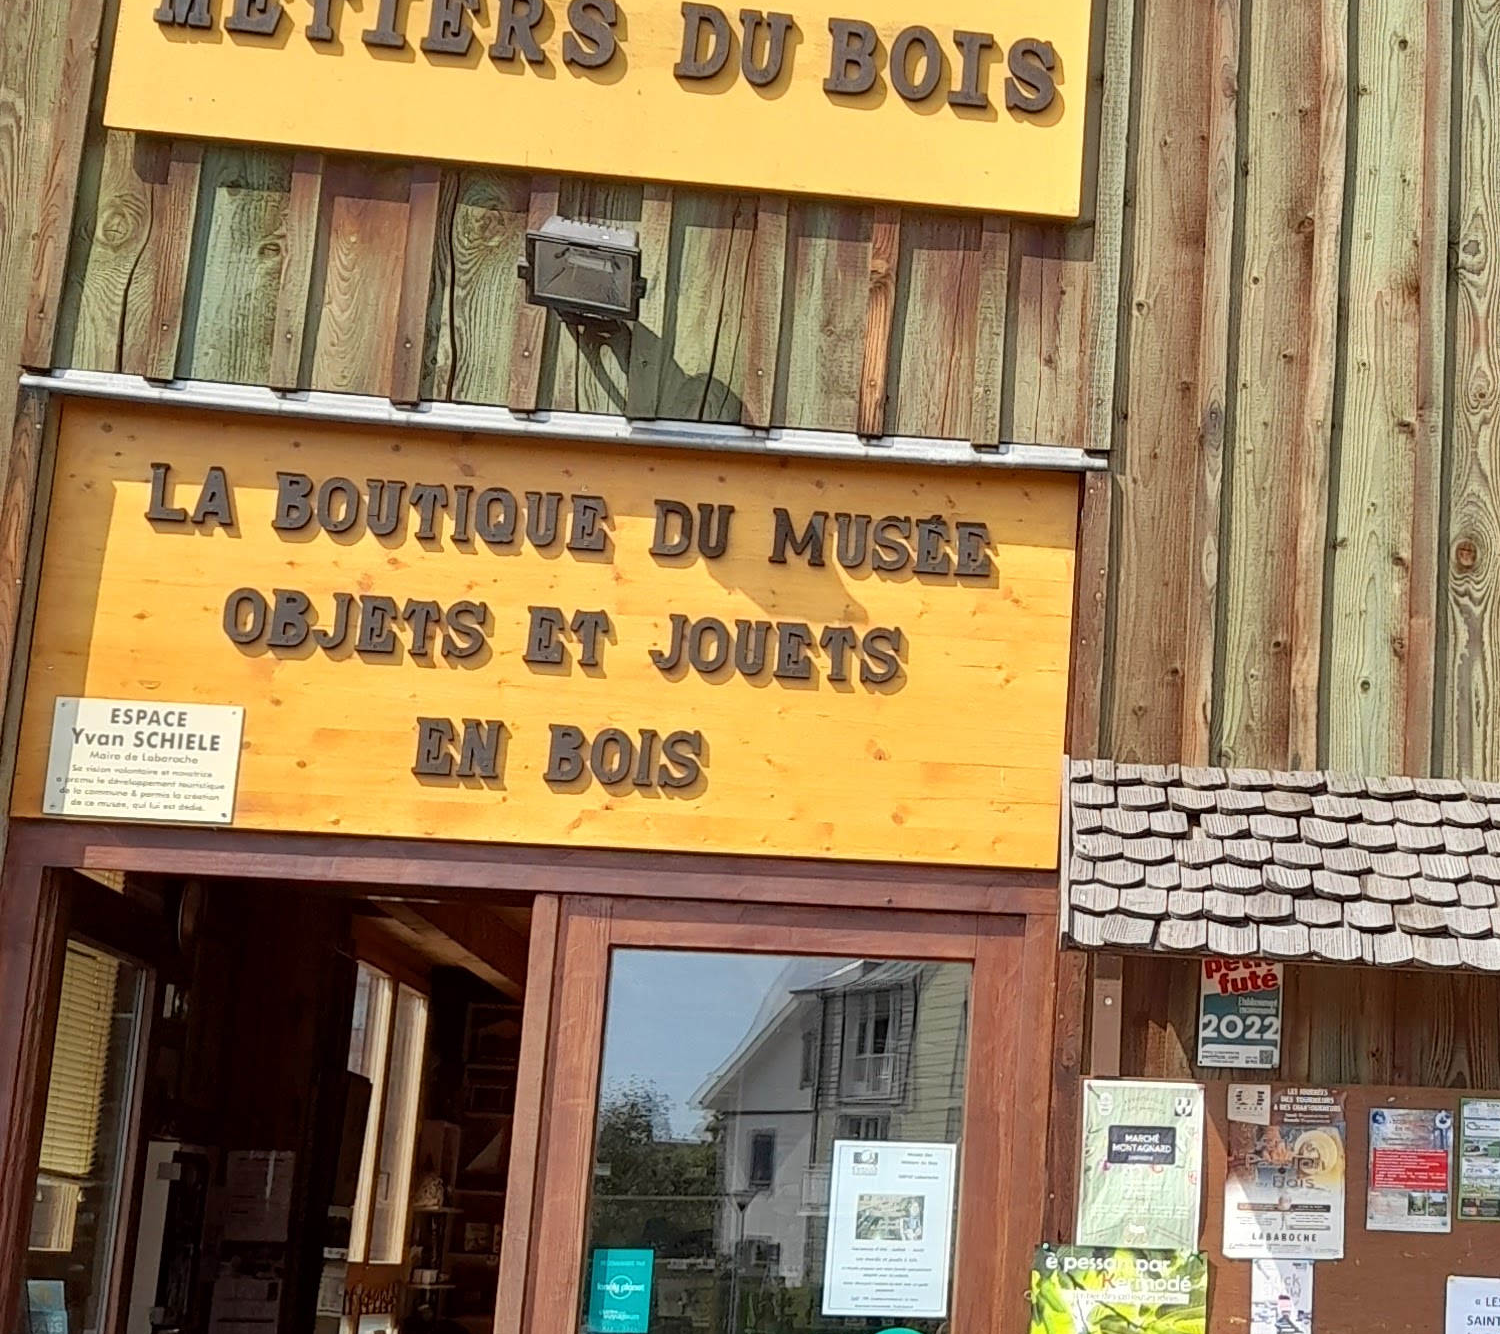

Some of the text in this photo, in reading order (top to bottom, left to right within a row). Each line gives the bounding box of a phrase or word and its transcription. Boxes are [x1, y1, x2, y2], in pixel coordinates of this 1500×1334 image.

[674, 1, 797, 88] DU
[822, 16, 1063, 114] BOIS
[144, 463, 998, 580] LA BOUTIQUE DU MUSÉE
[222, 586, 908, 687] OBJETS ET JOUETS
[110, 708, 188, 727] ESPACE
[71, 727, 221, 751] Yvan SCHIELE
[89, 751, 199, 765] Maire de Labaroche
[414, 716, 706, 791] EN BOIS
[84, 788, 128, 797] commune
[1218, 968, 1278, 995] futé
[1202, 1013, 1279, 1040] 2022
[1112, 1143, 1172, 1154] MONTAGNARD
[1124, 1133, 1160, 1144] MARCHÉ
[1252, 1232, 1317, 1242] LABAROCHE
[1135, 1258, 1171, 1273] par
[1101, 1272, 1192, 1293] Kermodé
